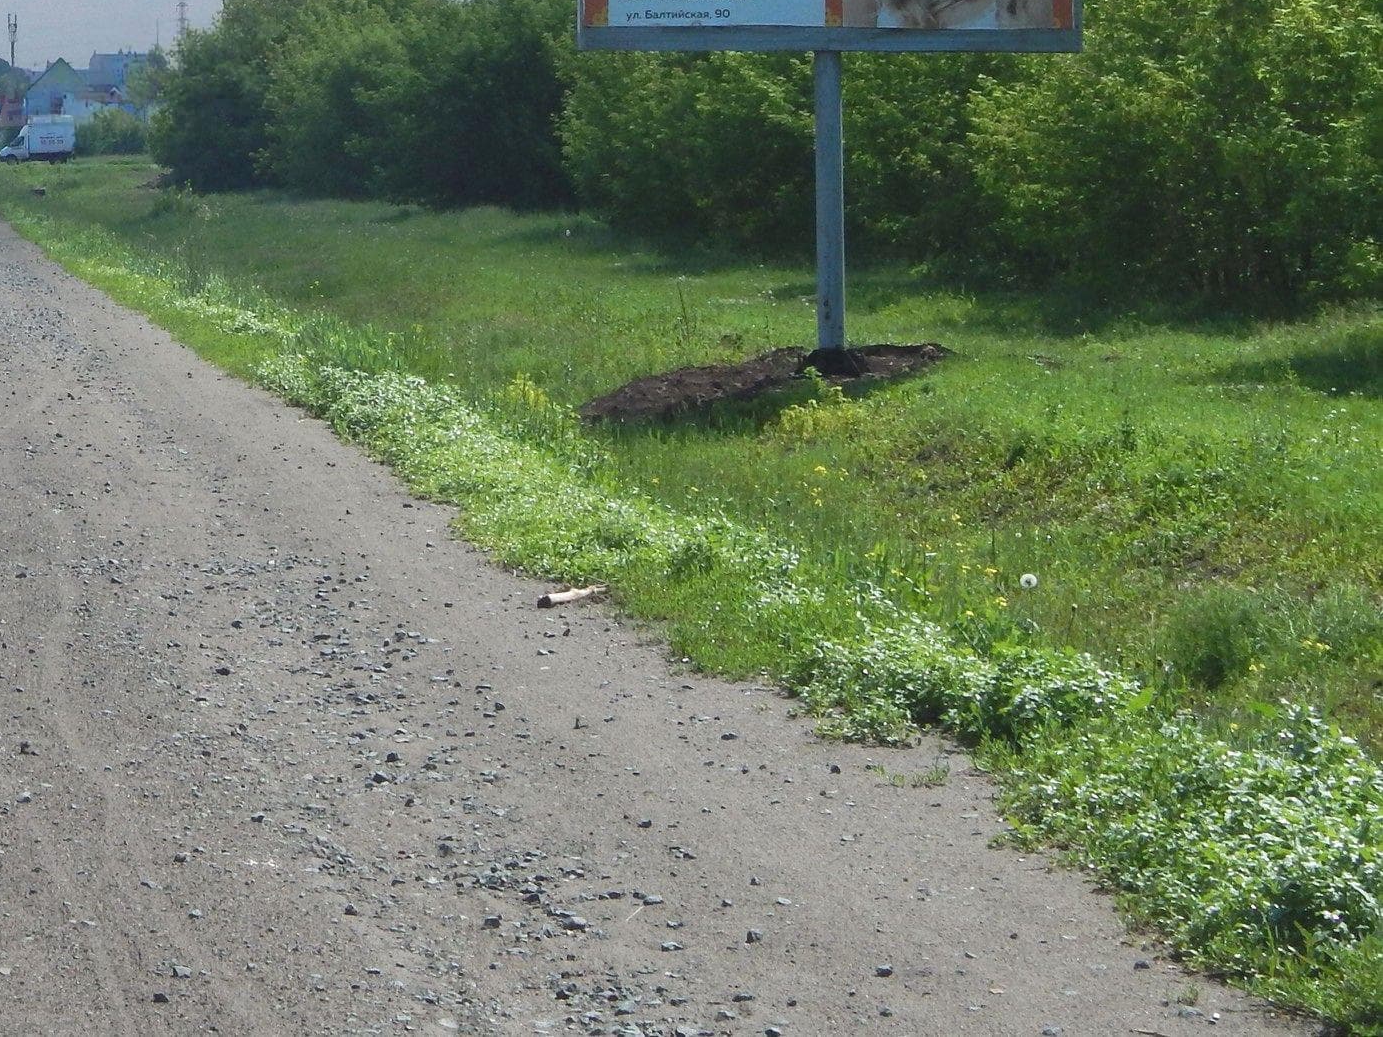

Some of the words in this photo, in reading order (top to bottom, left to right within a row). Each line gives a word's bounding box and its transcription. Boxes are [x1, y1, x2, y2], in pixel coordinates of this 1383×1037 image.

[626, 13, 642, 22] ул.
[644, 10, 712, 20] Балтийская,
[714, 9, 731, 19] 90
